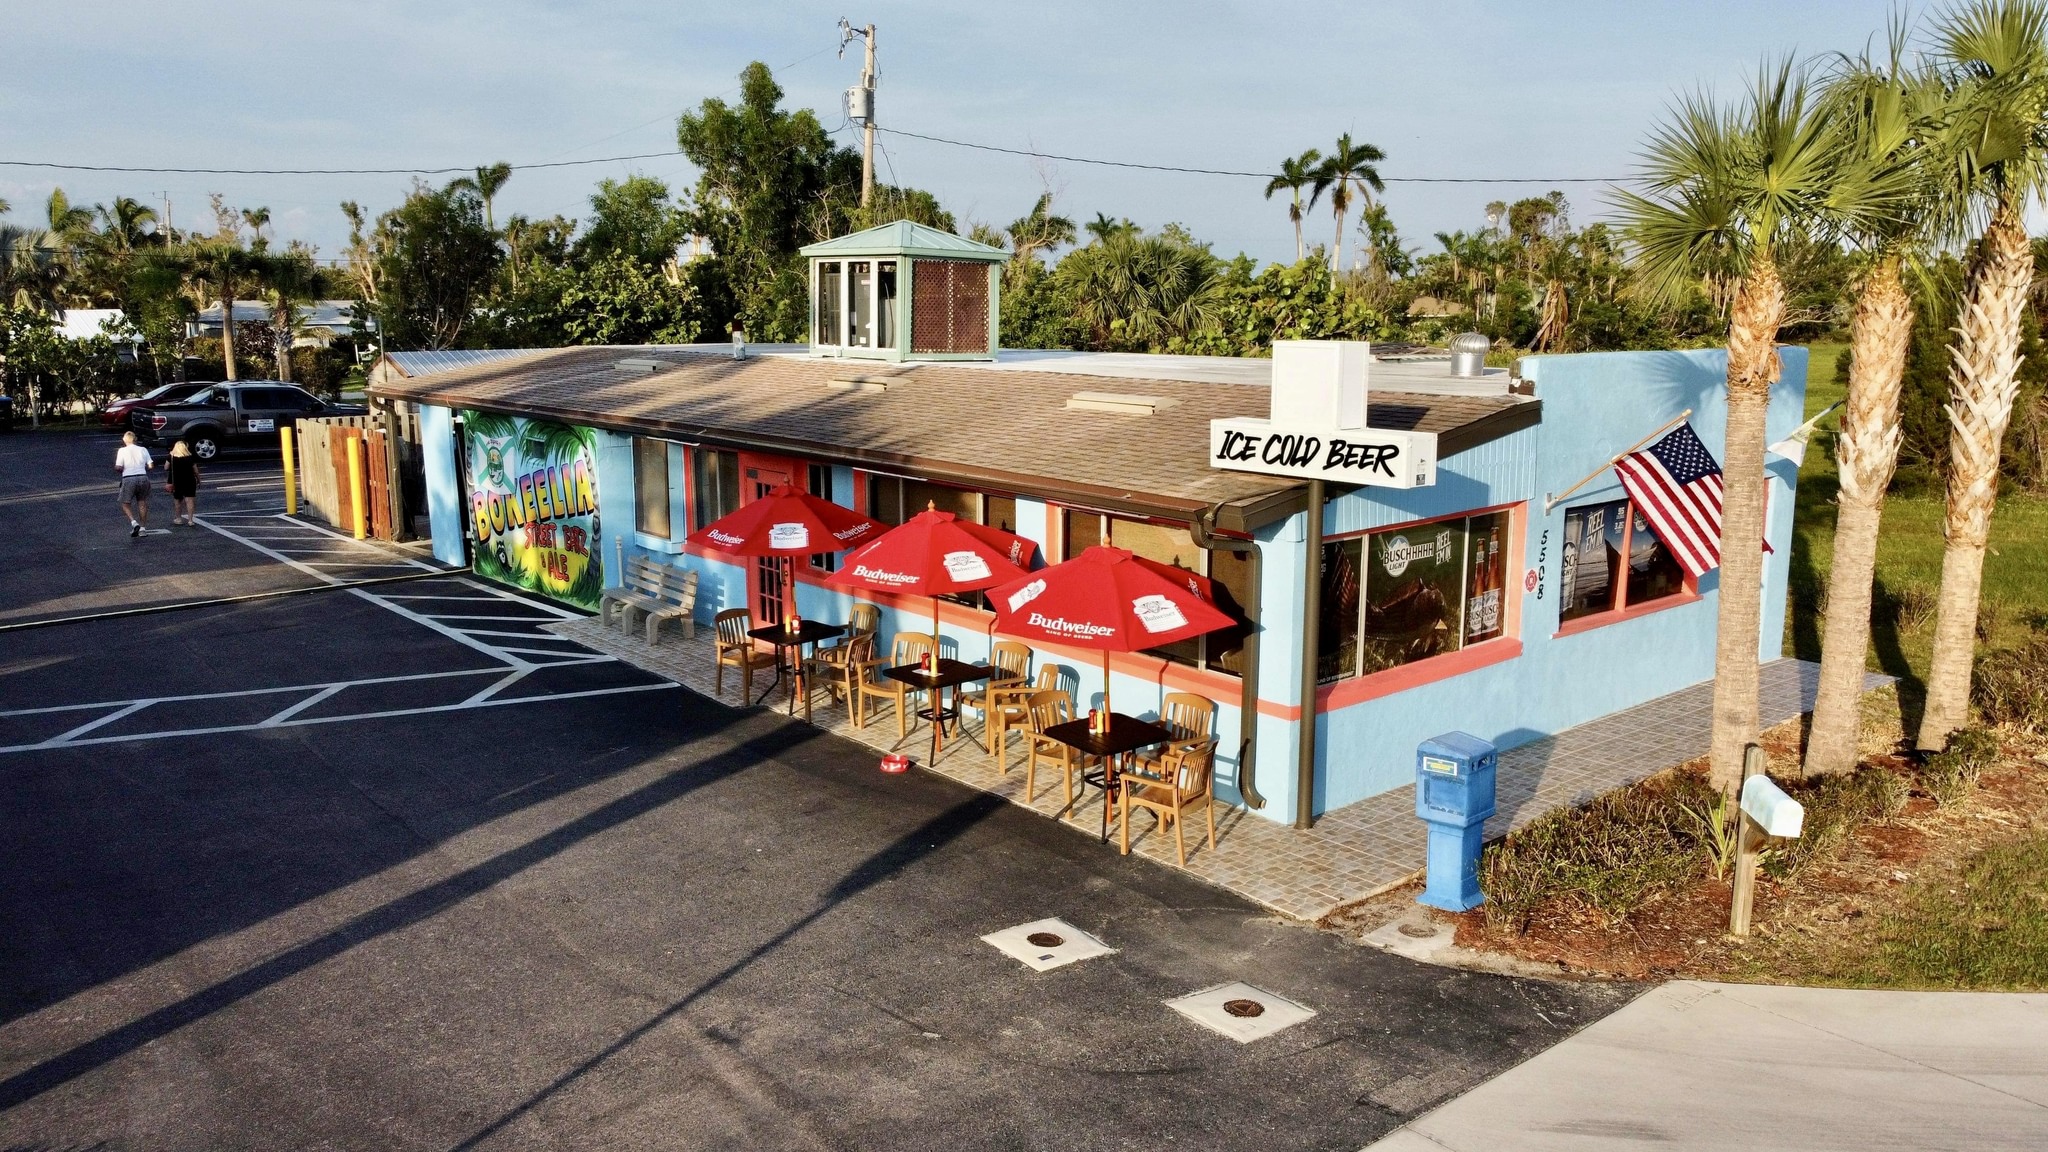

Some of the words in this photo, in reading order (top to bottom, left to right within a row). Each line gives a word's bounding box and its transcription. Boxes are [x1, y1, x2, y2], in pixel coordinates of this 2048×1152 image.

[1216, 430, 1262, 462] ICE
[1261, 433, 1321, 468] COLD
[1322, 438, 1400, 478] BEER
[524, 522, 557, 549] STREET
[706, 529, 745, 545] Budweiser
[832, 522, 872, 540] Budweiser
[548, 551, 569, 582] ALE
[852, 565, 921, 584] Budweiser
[1389, 561, 1406, 571] LIGHT
[1537, 529, 1549, 599] 5508
[1027, 612, 1116, 637] Budweiser
